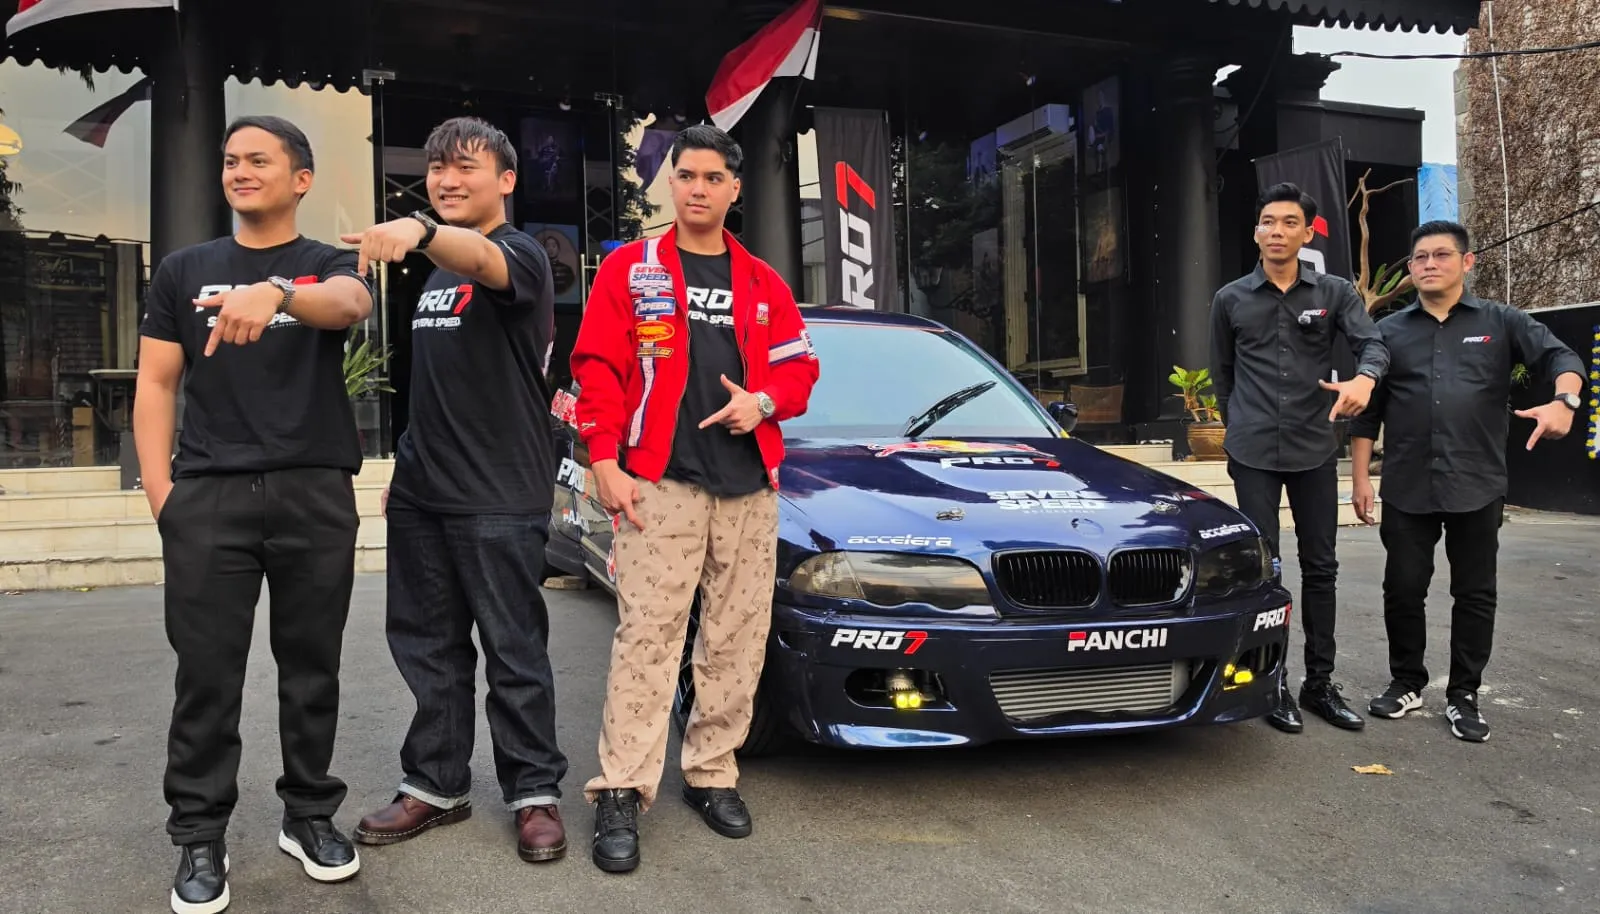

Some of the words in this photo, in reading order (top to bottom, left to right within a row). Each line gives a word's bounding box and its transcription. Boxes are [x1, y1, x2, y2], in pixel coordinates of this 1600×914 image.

[835, 161, 876, 310] RO7
[632, 273, 668, 281] SPEED
[687, 286, 734, 310] RO
[1462, 335, 1492, 344] PRO7
[940, 457, 1061, 468] PRO7
[986, 490, 1108, 500] SEVEN
[997, 500, 1112, 510] SPEED
[830, 628, 929, 654] PRO7
[1067, 628, 1168, 652] FANCHI
